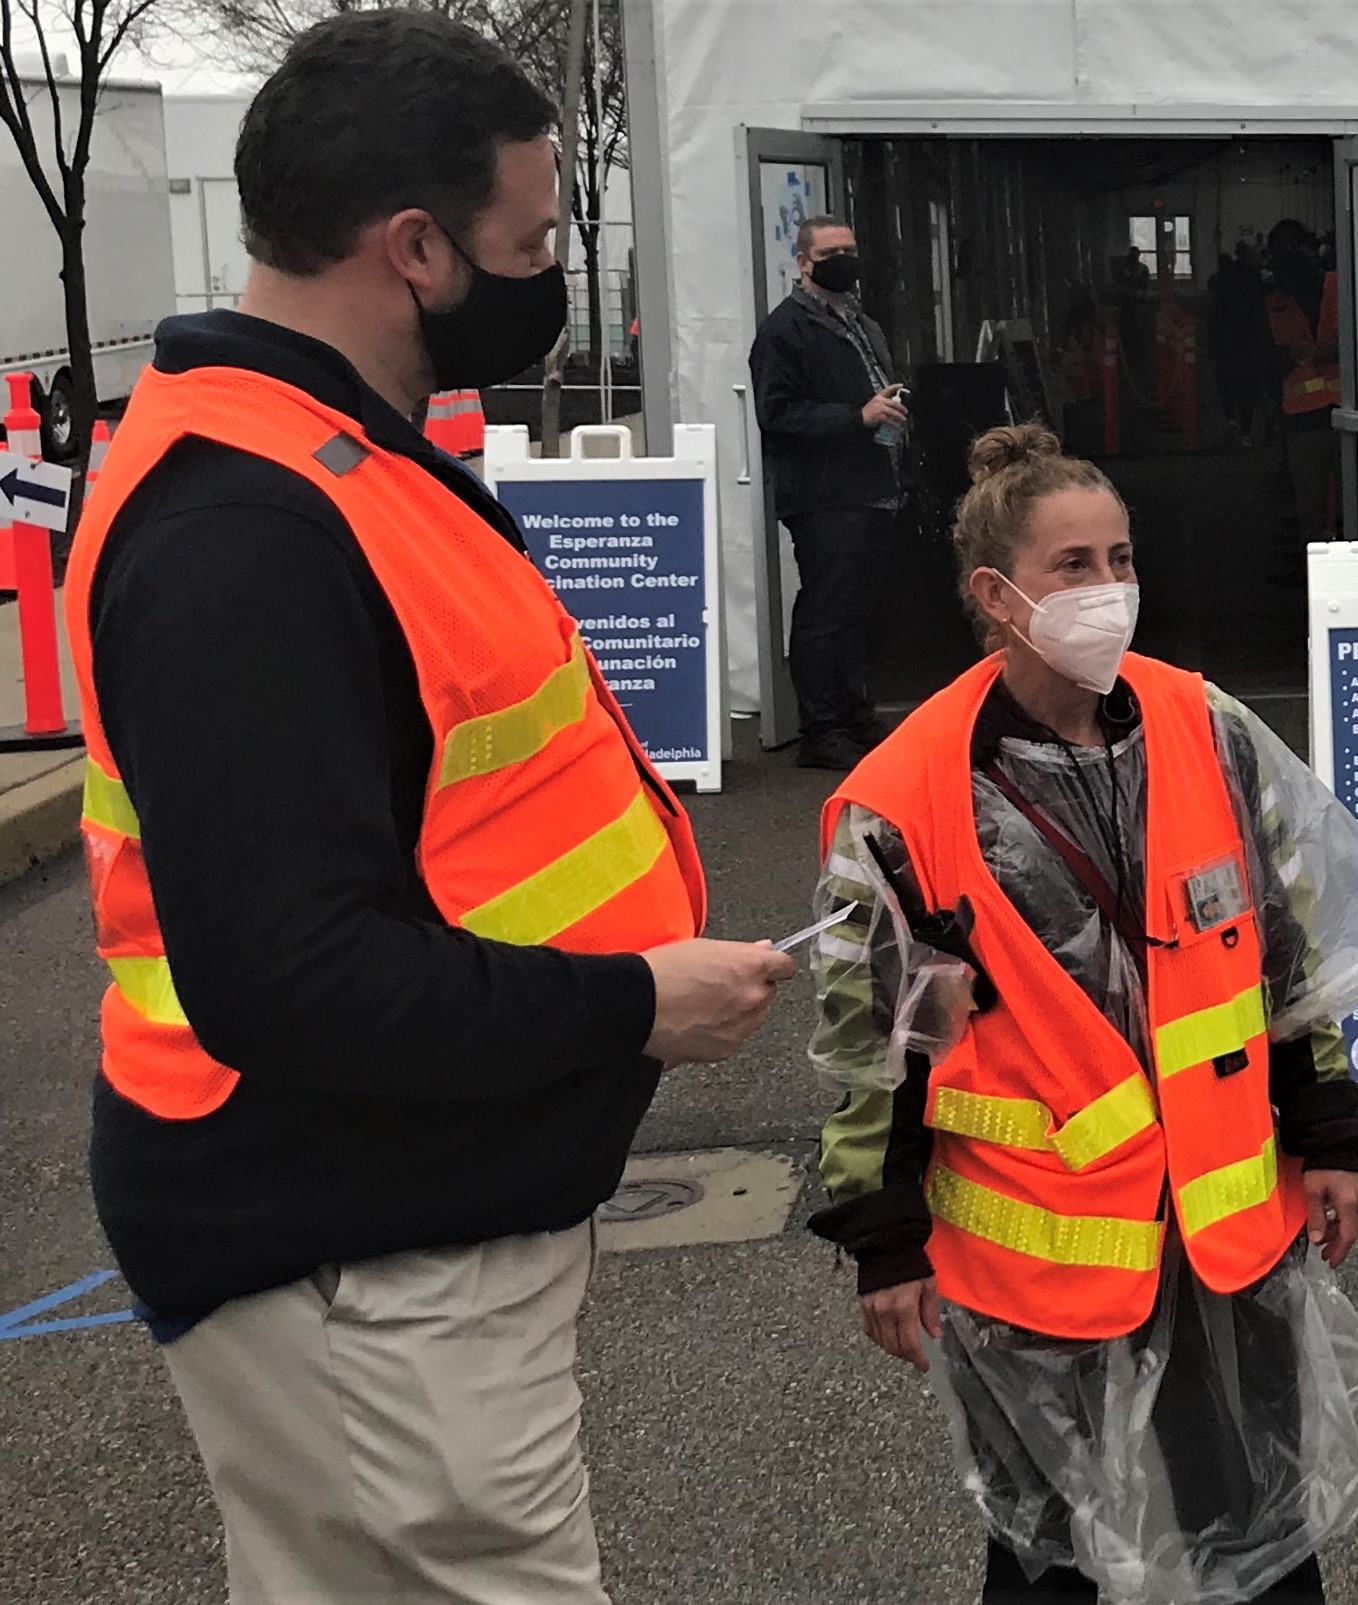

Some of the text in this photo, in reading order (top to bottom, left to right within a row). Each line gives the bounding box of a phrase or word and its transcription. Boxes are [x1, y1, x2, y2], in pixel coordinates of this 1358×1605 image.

[522, 513, 679, 528] Welcome to the
[550, 535, 653, 551] Esperanza
[545, 553, 658, 570] Community
[546, 574, 698, 589] cination Center
[656, 614, 674, 628] al
[598, 655, 676, 670] unación
